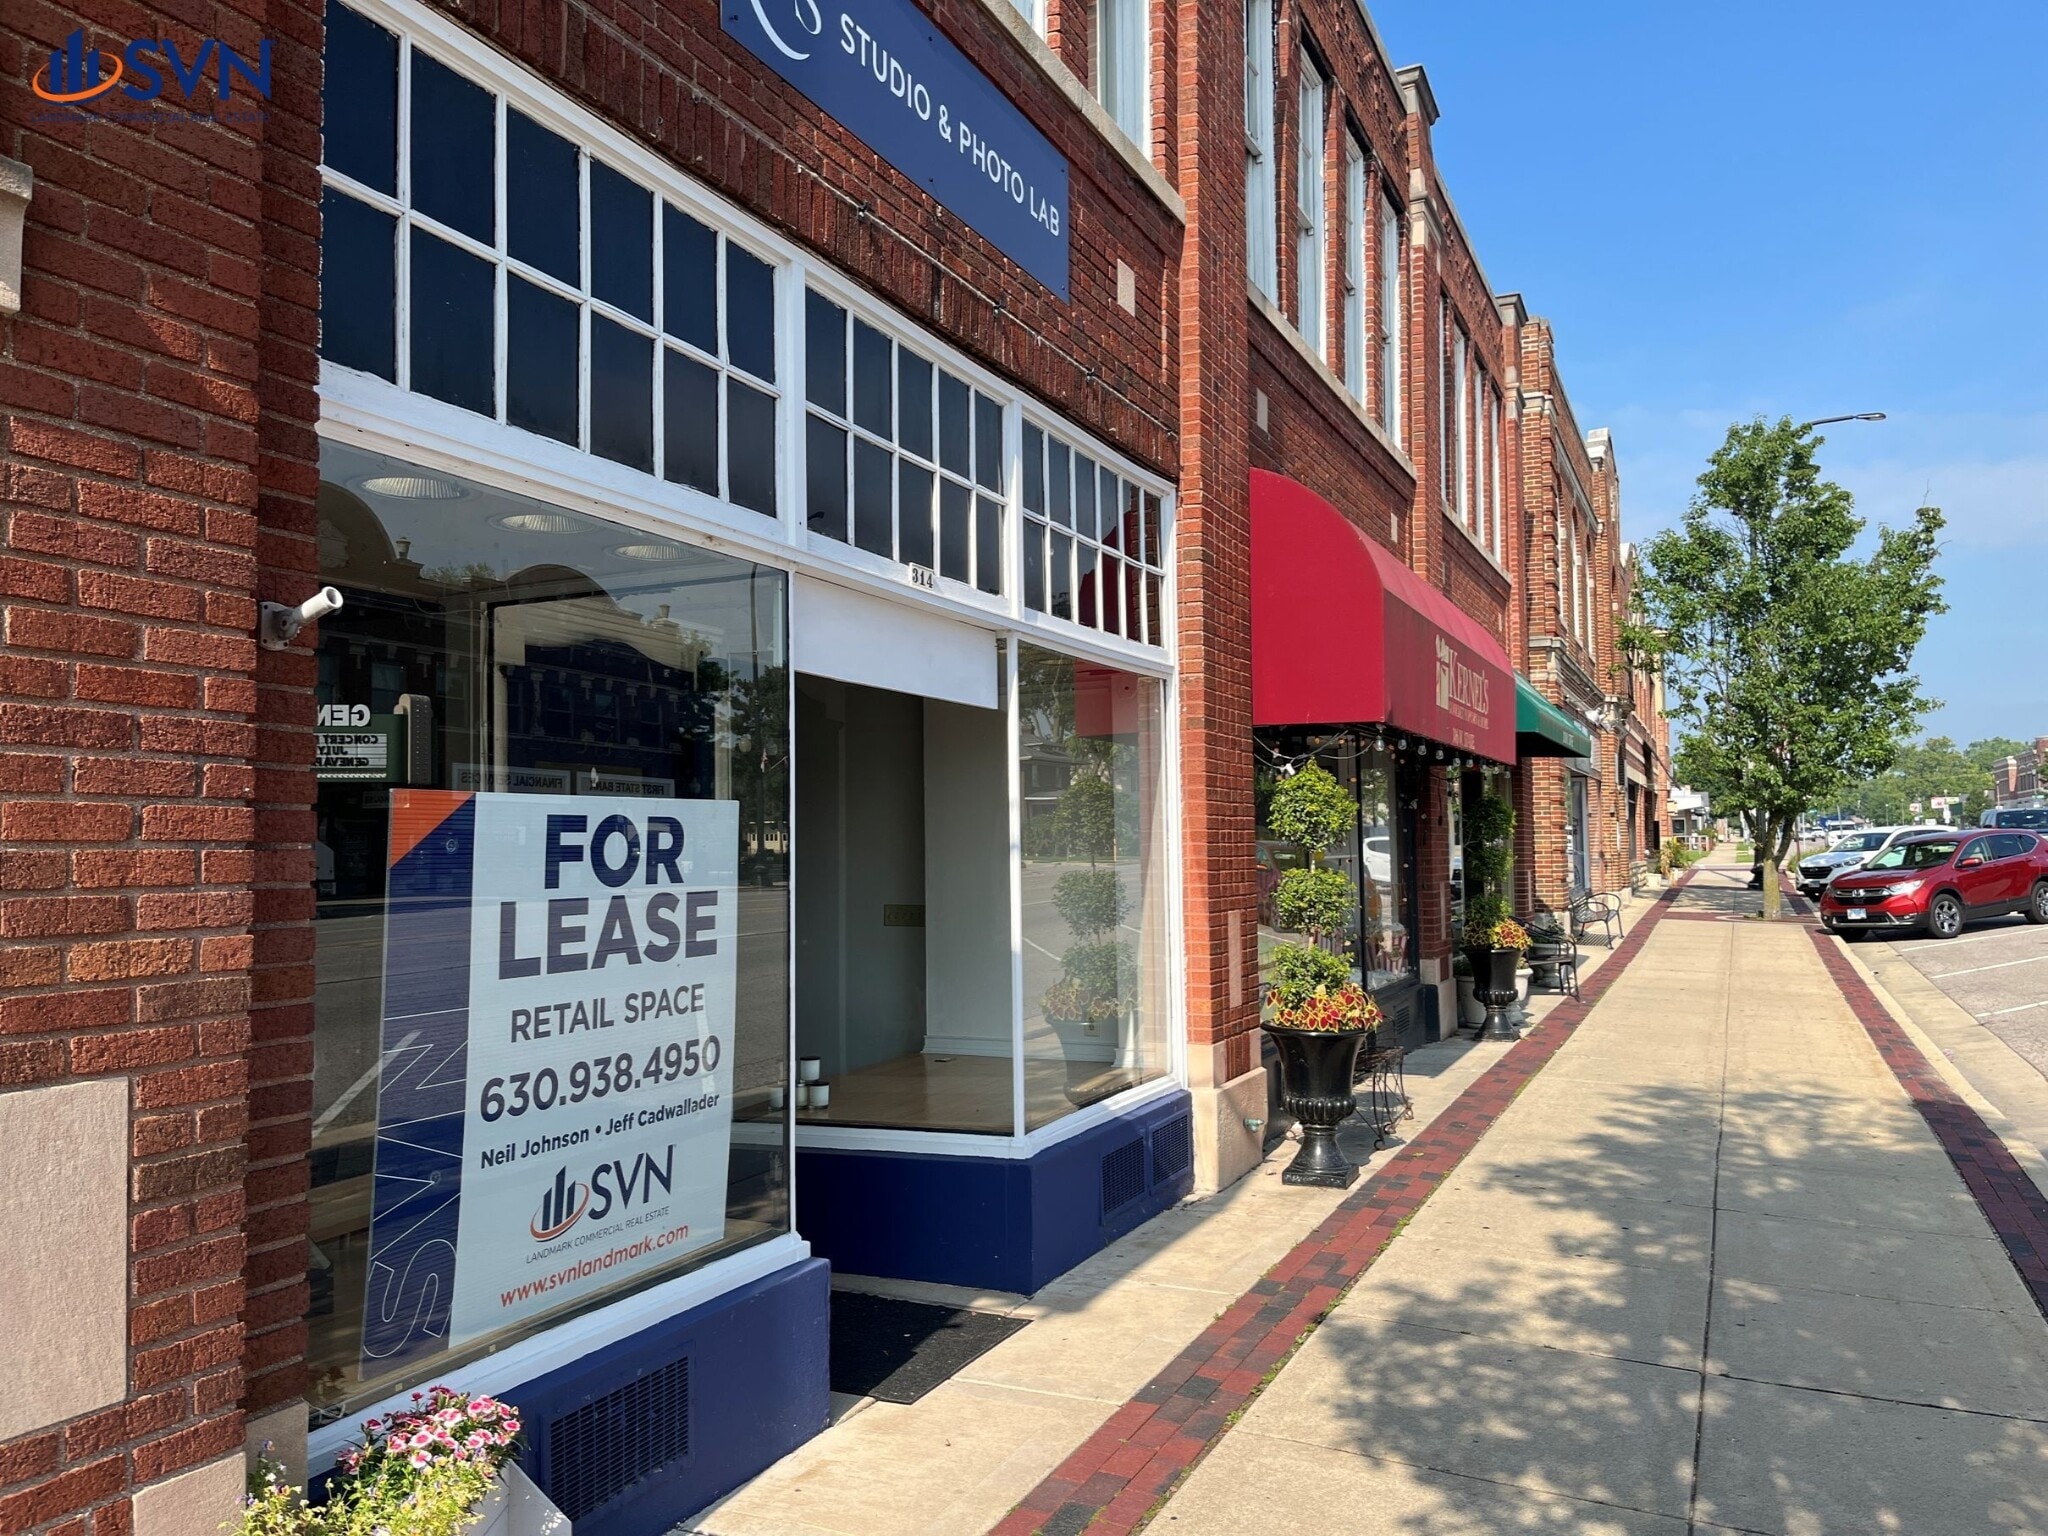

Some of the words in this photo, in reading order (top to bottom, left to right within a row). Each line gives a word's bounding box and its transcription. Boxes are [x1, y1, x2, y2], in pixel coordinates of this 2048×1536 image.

[841, 13, 931, 121] STUDIO
[939, 104, 951, 143] &
[960, 121, 1024, 204] PHOTO
[1030, 186, 1060, 237] LAB
[912, 567, 934, 589] 314
[544, 814, 685, 889] FOR
[498, 890, 718, 980] LEASE
[511, 998, 615, 1043] RETAIL
[624, 983, 705, 1024] SPACE
[480, 1035, 721, 1123] 630.938.4950
[480, 1143, 516, 1169] Neil
[520, 1128, 590, 1159] Johnson
[604, 1113, 635, 1136] Jeff
[637, 1093, 720, 1127] Cadwallader
[587, 1143, 675, 1221] SVN
[500, 1224, 689, 1308] www.svnlandmark.com
[526, 1240, 573, 1264] LANDMARK
[574, 1223, 623, 1247] COMMERCIAL
[625, 1216, 643, 1229] REAL
[645, 1206, 670, 1222] ESTATE
